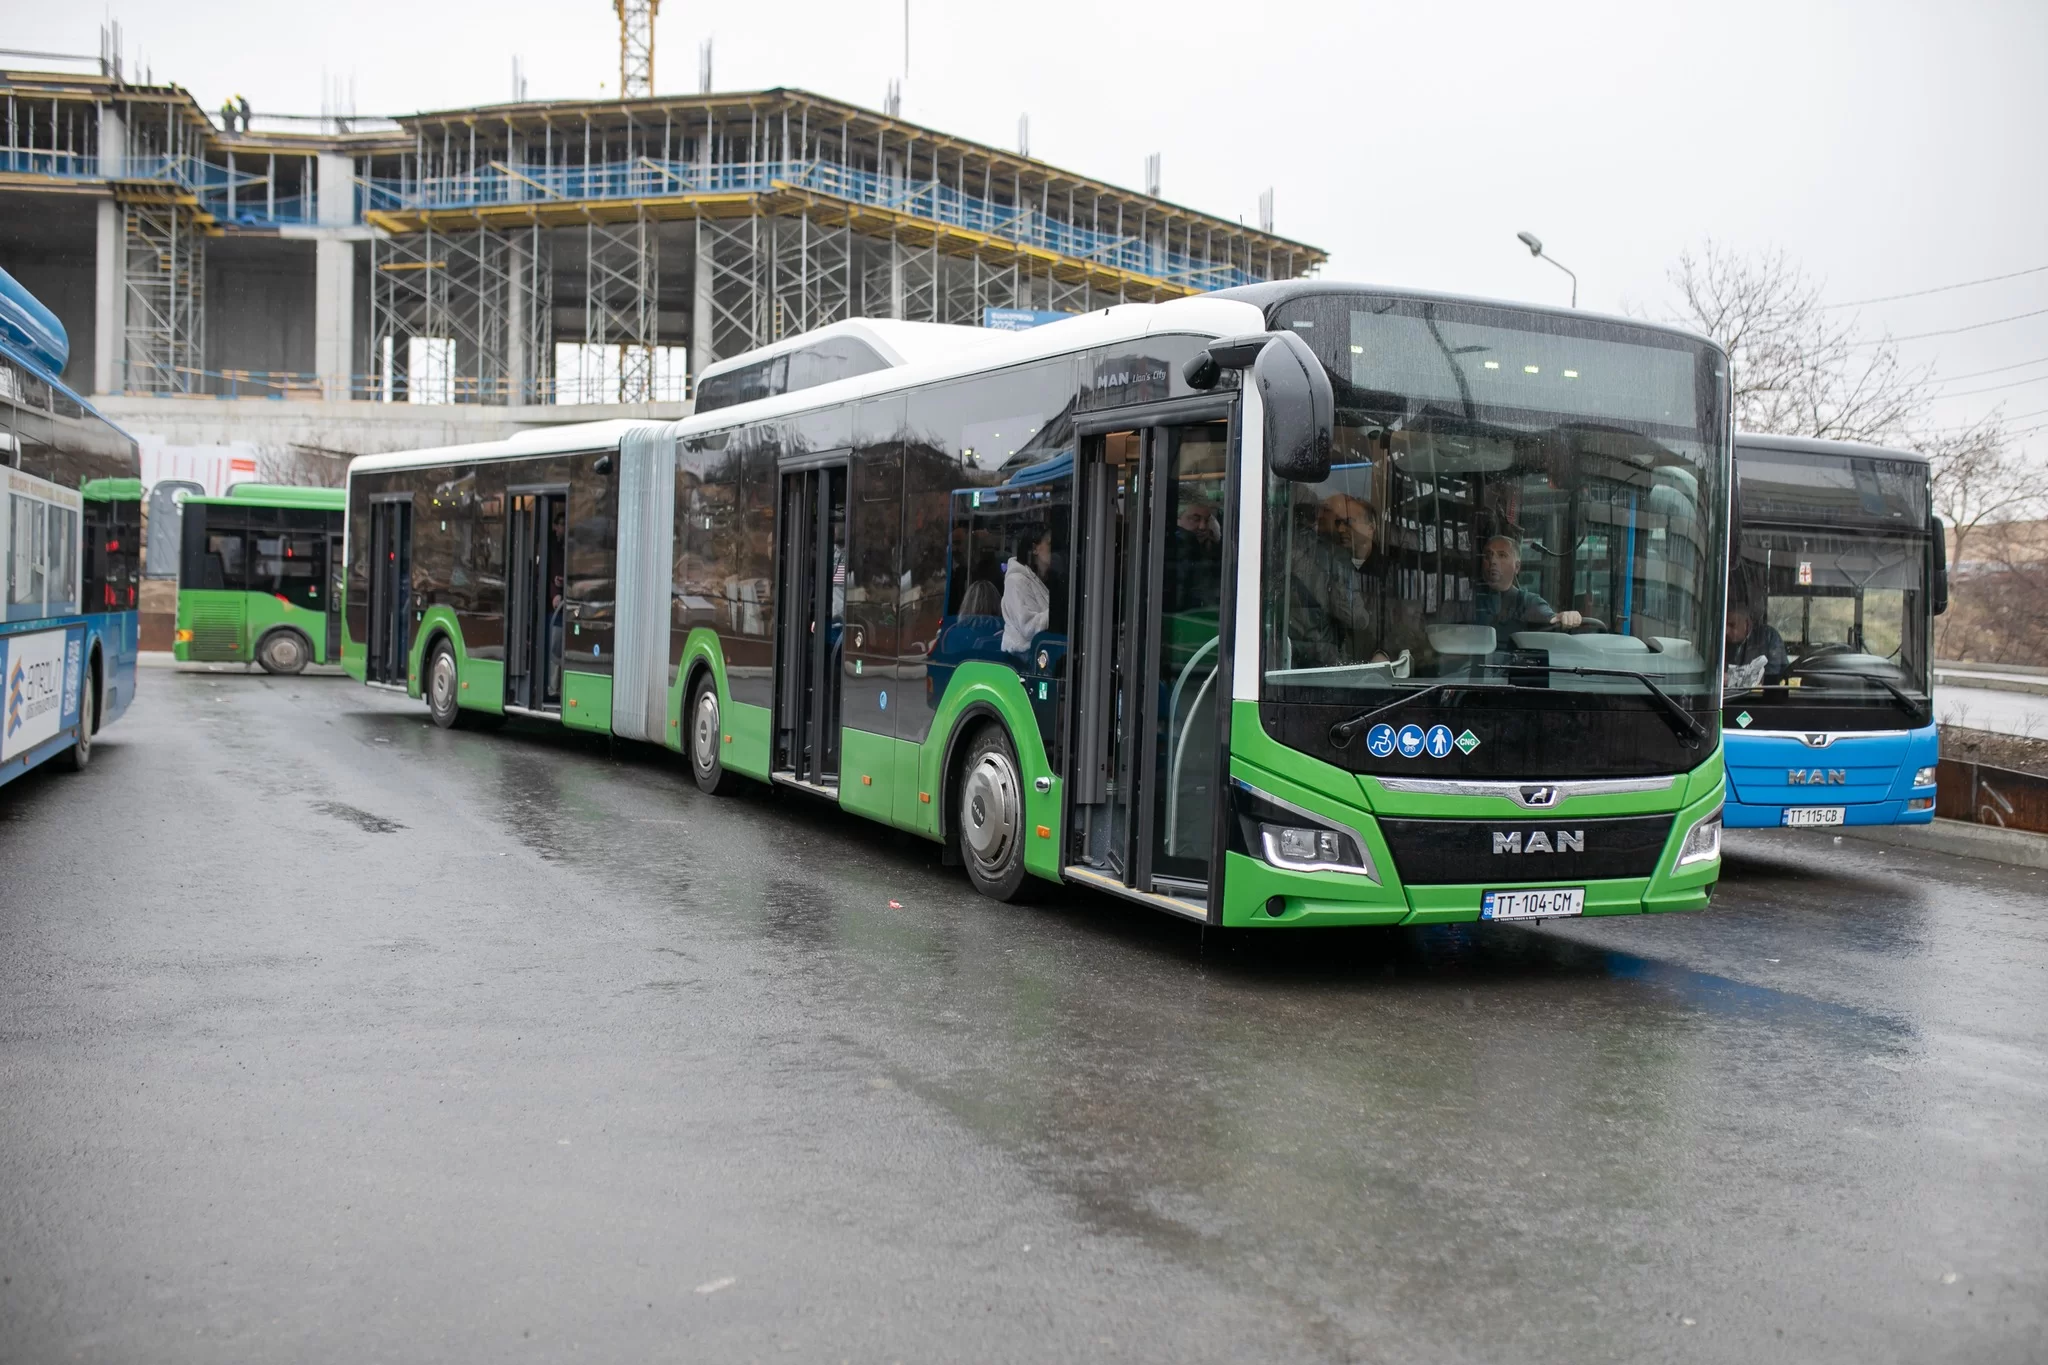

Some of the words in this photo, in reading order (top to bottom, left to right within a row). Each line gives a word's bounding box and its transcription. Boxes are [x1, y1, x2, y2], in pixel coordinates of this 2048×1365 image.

[1097, 371, 1129, 389] MAN
[1132, 372, 1151, 383] Lion's
[1152, 369, 1167, 381] City
[1459, 738, 1476, 747] CNG
[1788, 769, 1846, 785] MAN
[972, 801, 984, 822] MAN
[1791, 810, 1837, 823] TT-115-CB
[1492, 830, 1585, 854] MAN
[1484, 907, 1493, 916] GE
[1497, 893, 1572, 915] TT-104-CM
